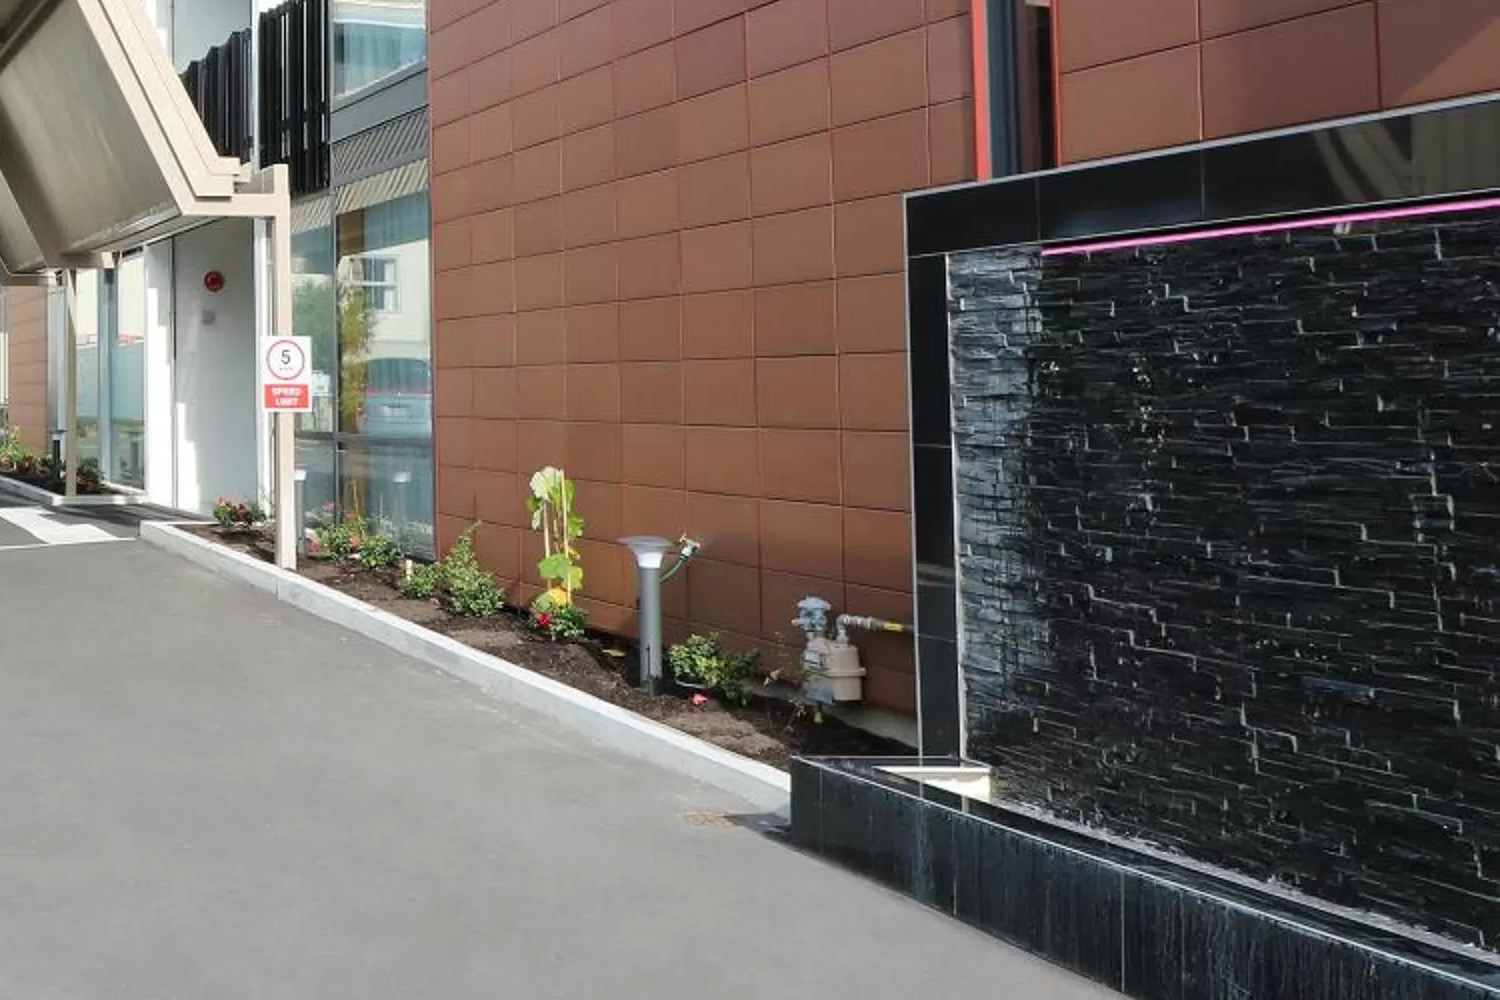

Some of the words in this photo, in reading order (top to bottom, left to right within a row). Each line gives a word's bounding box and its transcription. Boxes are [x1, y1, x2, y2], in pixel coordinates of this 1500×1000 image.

[281, 349, 291, 365] 5
[272, 387, 302, 396] SPEED
[275, 397, 298, 406] LIMIT
